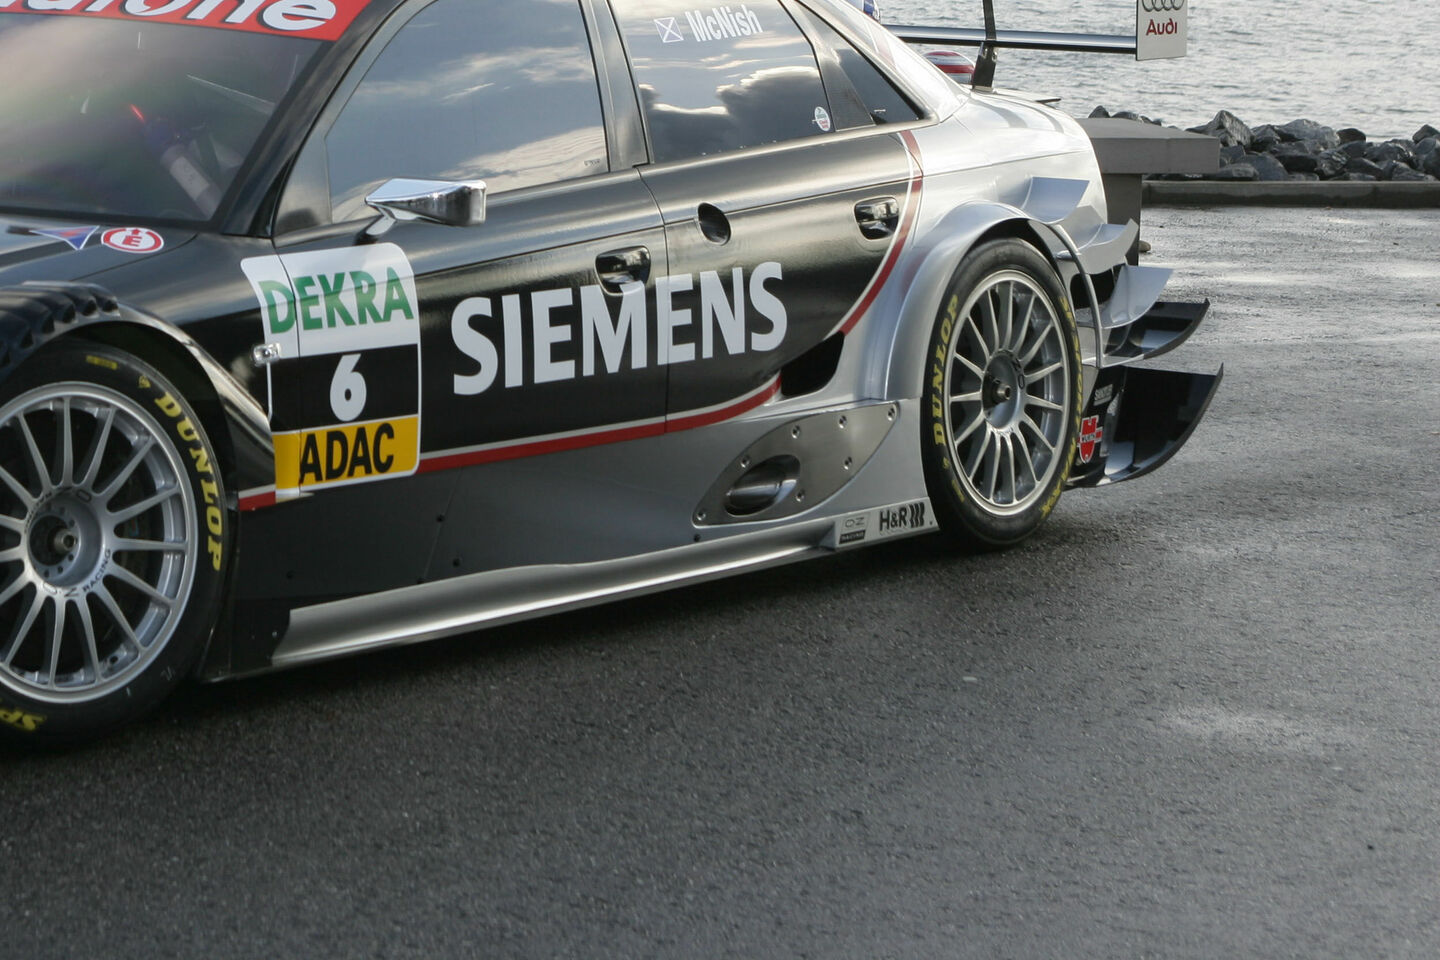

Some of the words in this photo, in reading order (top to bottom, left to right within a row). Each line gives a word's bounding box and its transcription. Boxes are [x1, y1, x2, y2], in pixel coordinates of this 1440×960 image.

[684, 4, 763, 42] McNish
[1146, 18, 1178, 36] Audi
[258, 266, 414, 335] DEKRA
[450, 261, 788, 396] SIEMENS
[329, 354, 367, 422] 6
[932, 294, 959, 447] DUNLOP
[154, 391, 224, 571] DUNLOP
[298, 423, 395, 485] ADAC
[879, 506, 908, 531] H&R
[82, 548, 112, 592] RACING
